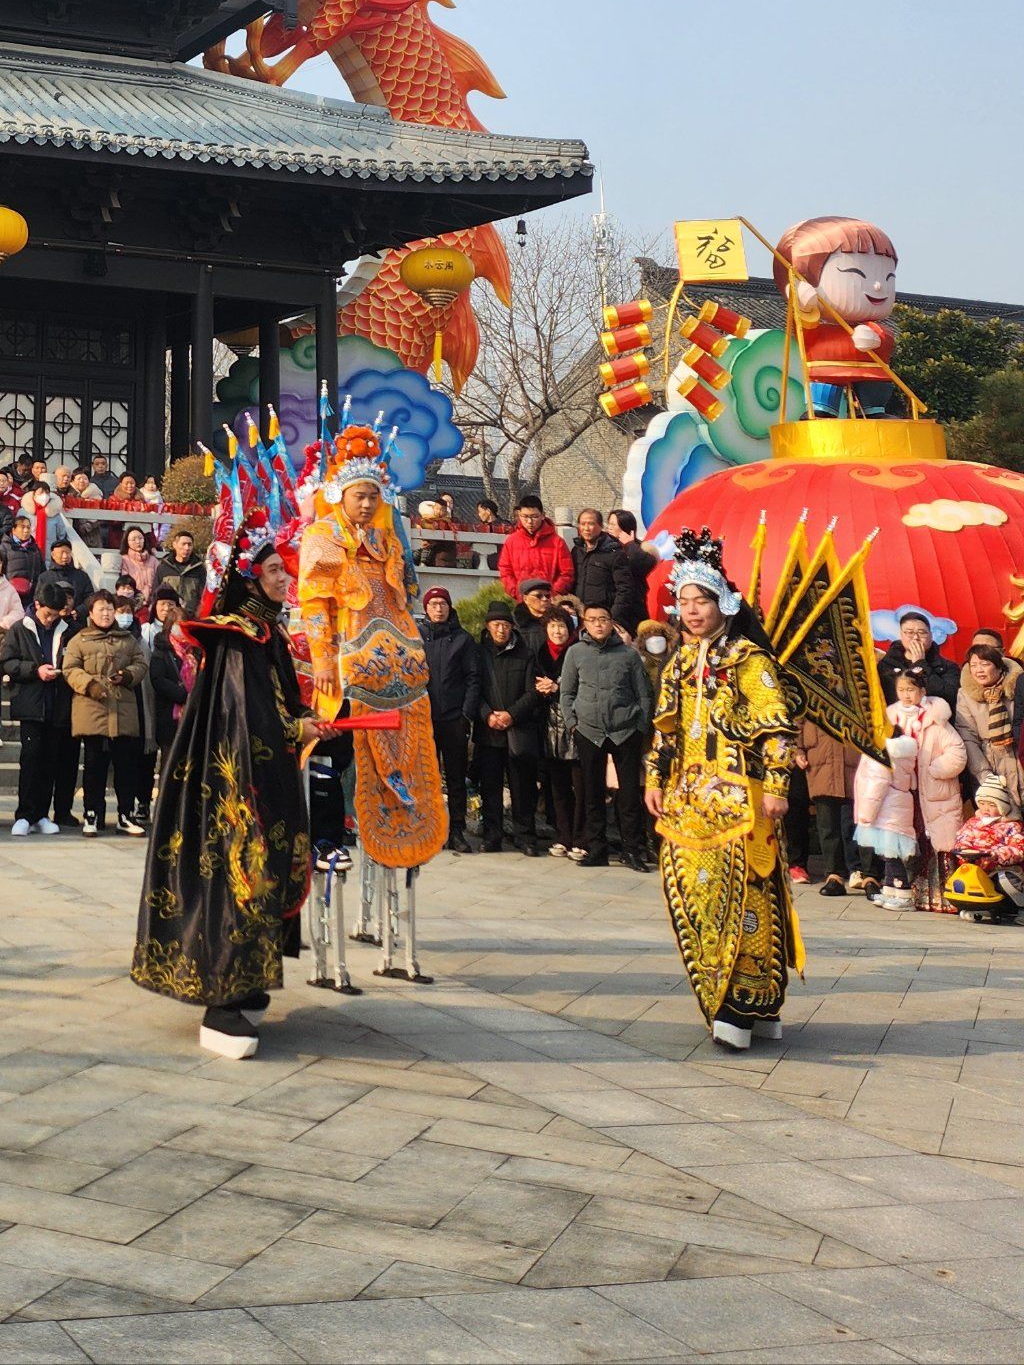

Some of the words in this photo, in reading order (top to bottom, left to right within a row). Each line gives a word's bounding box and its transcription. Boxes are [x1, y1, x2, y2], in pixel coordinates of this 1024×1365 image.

[696, 227, 735, 269] 福
[424, 259, 453, 271] 水云阁
